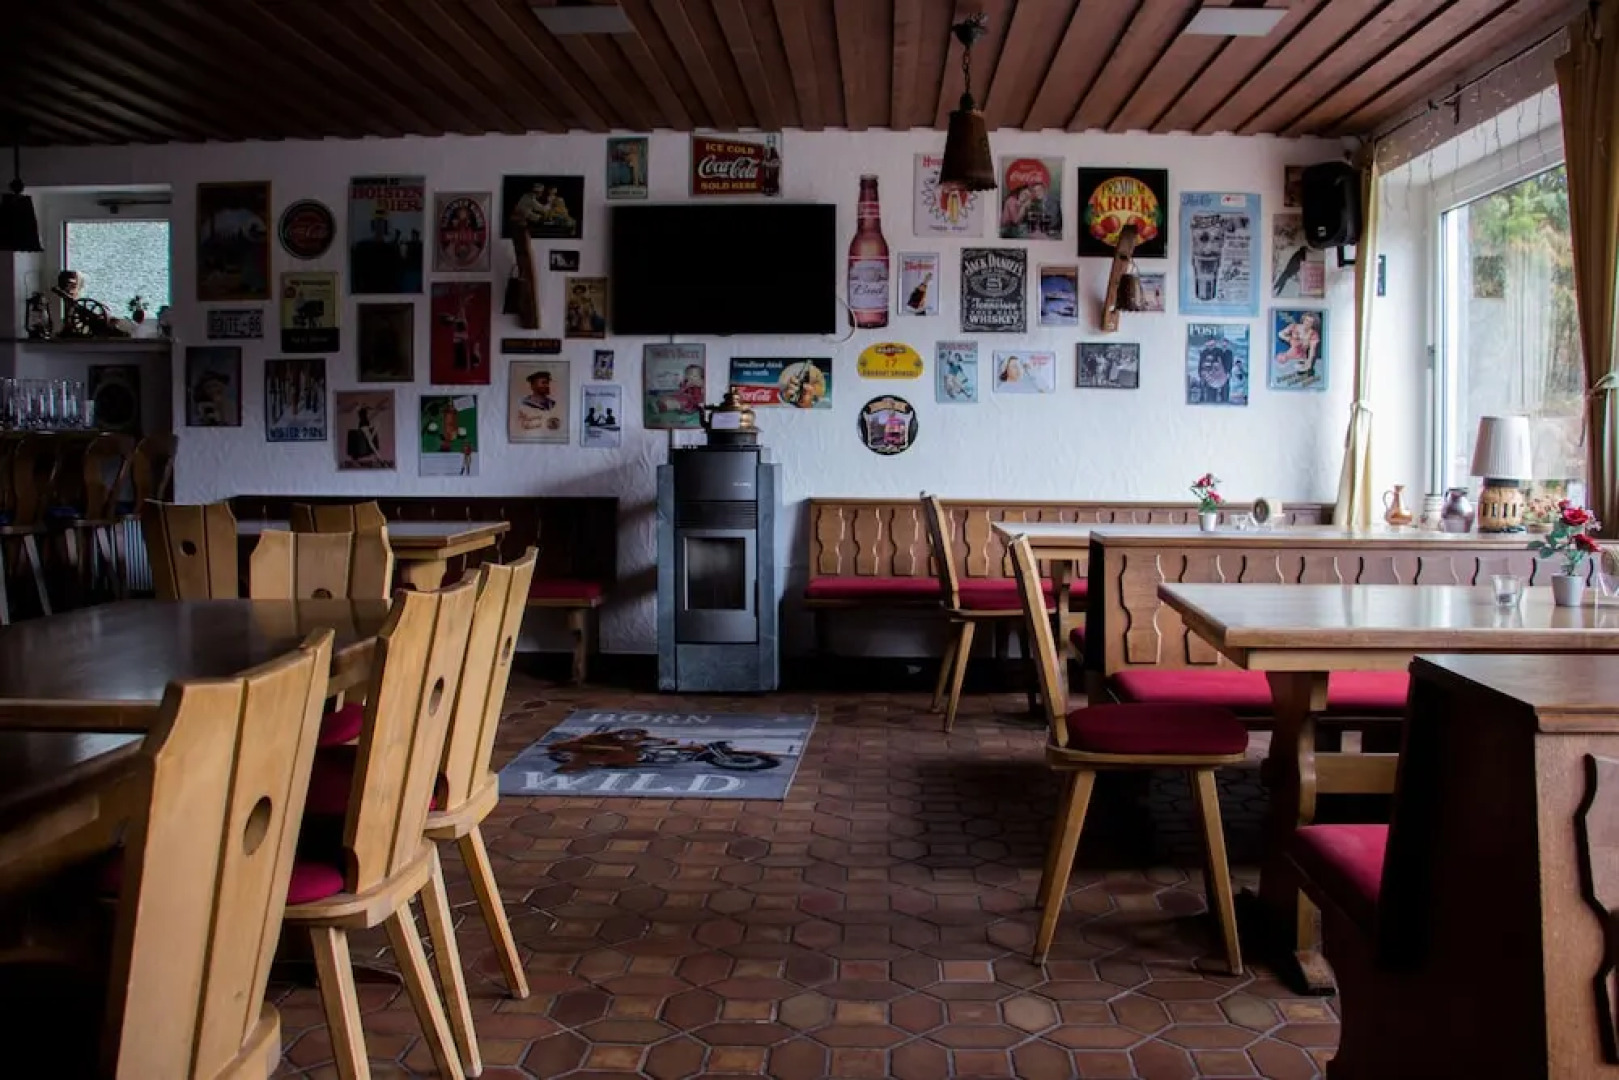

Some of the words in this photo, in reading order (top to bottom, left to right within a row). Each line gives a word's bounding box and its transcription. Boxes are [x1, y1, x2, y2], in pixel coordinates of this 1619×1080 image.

[697, 154, 759, 179] Coca-Cola
[1093, 194, 1152, 213] KRIEK
[964, 258, 988, 276] JACK
[969, 315, 1019, 325] WHISKEY
[1189, 325, 1218, 337] POST
[587, 713, 712, 725] BORN
[521, 771, 748, 793] WILD
